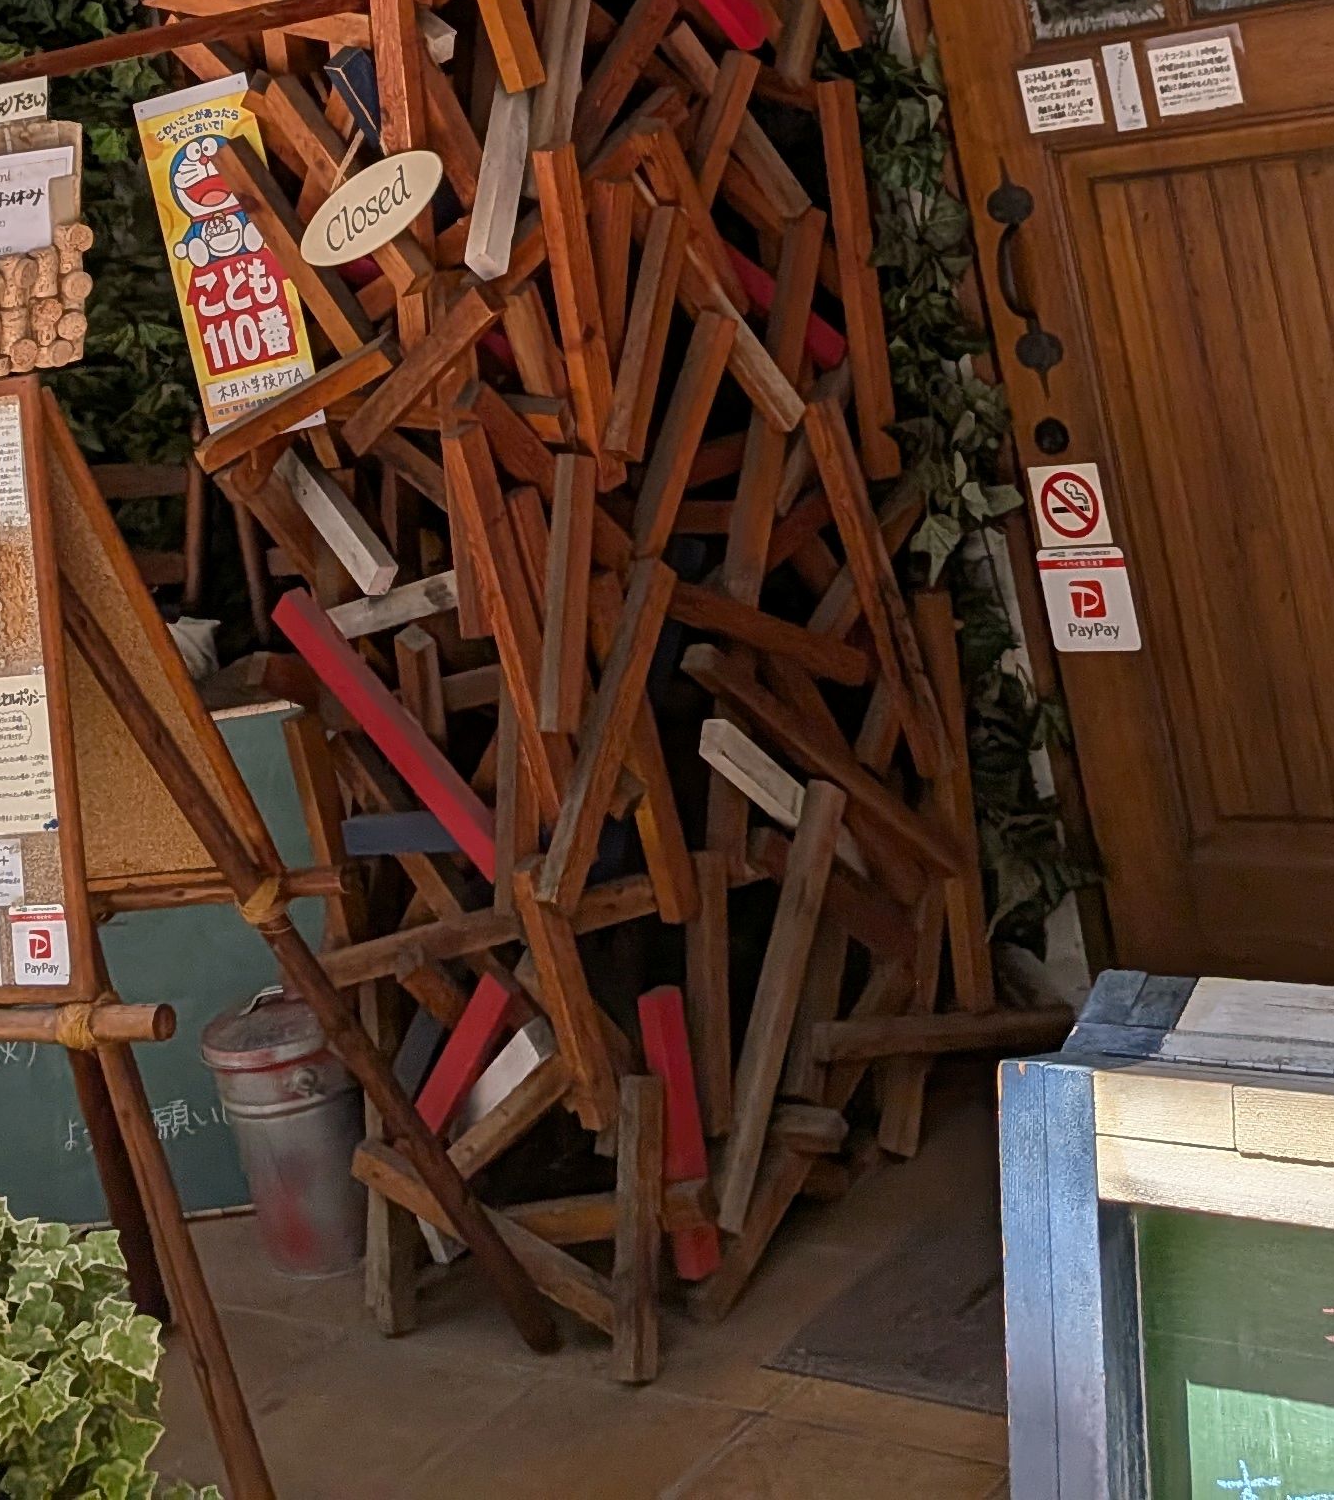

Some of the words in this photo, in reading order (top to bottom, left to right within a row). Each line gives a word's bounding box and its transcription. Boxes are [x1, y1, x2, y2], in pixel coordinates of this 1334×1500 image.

[155, 108, 239, 143] こわいことがあったら
[325, 164, 412, 252] Closed
[194, 257, 279, 318] こども
[202, 305, 292, 370] 110番
[1068, 622, 1120, 639] PayPay
[24, 962, 60, 977] PayPay
